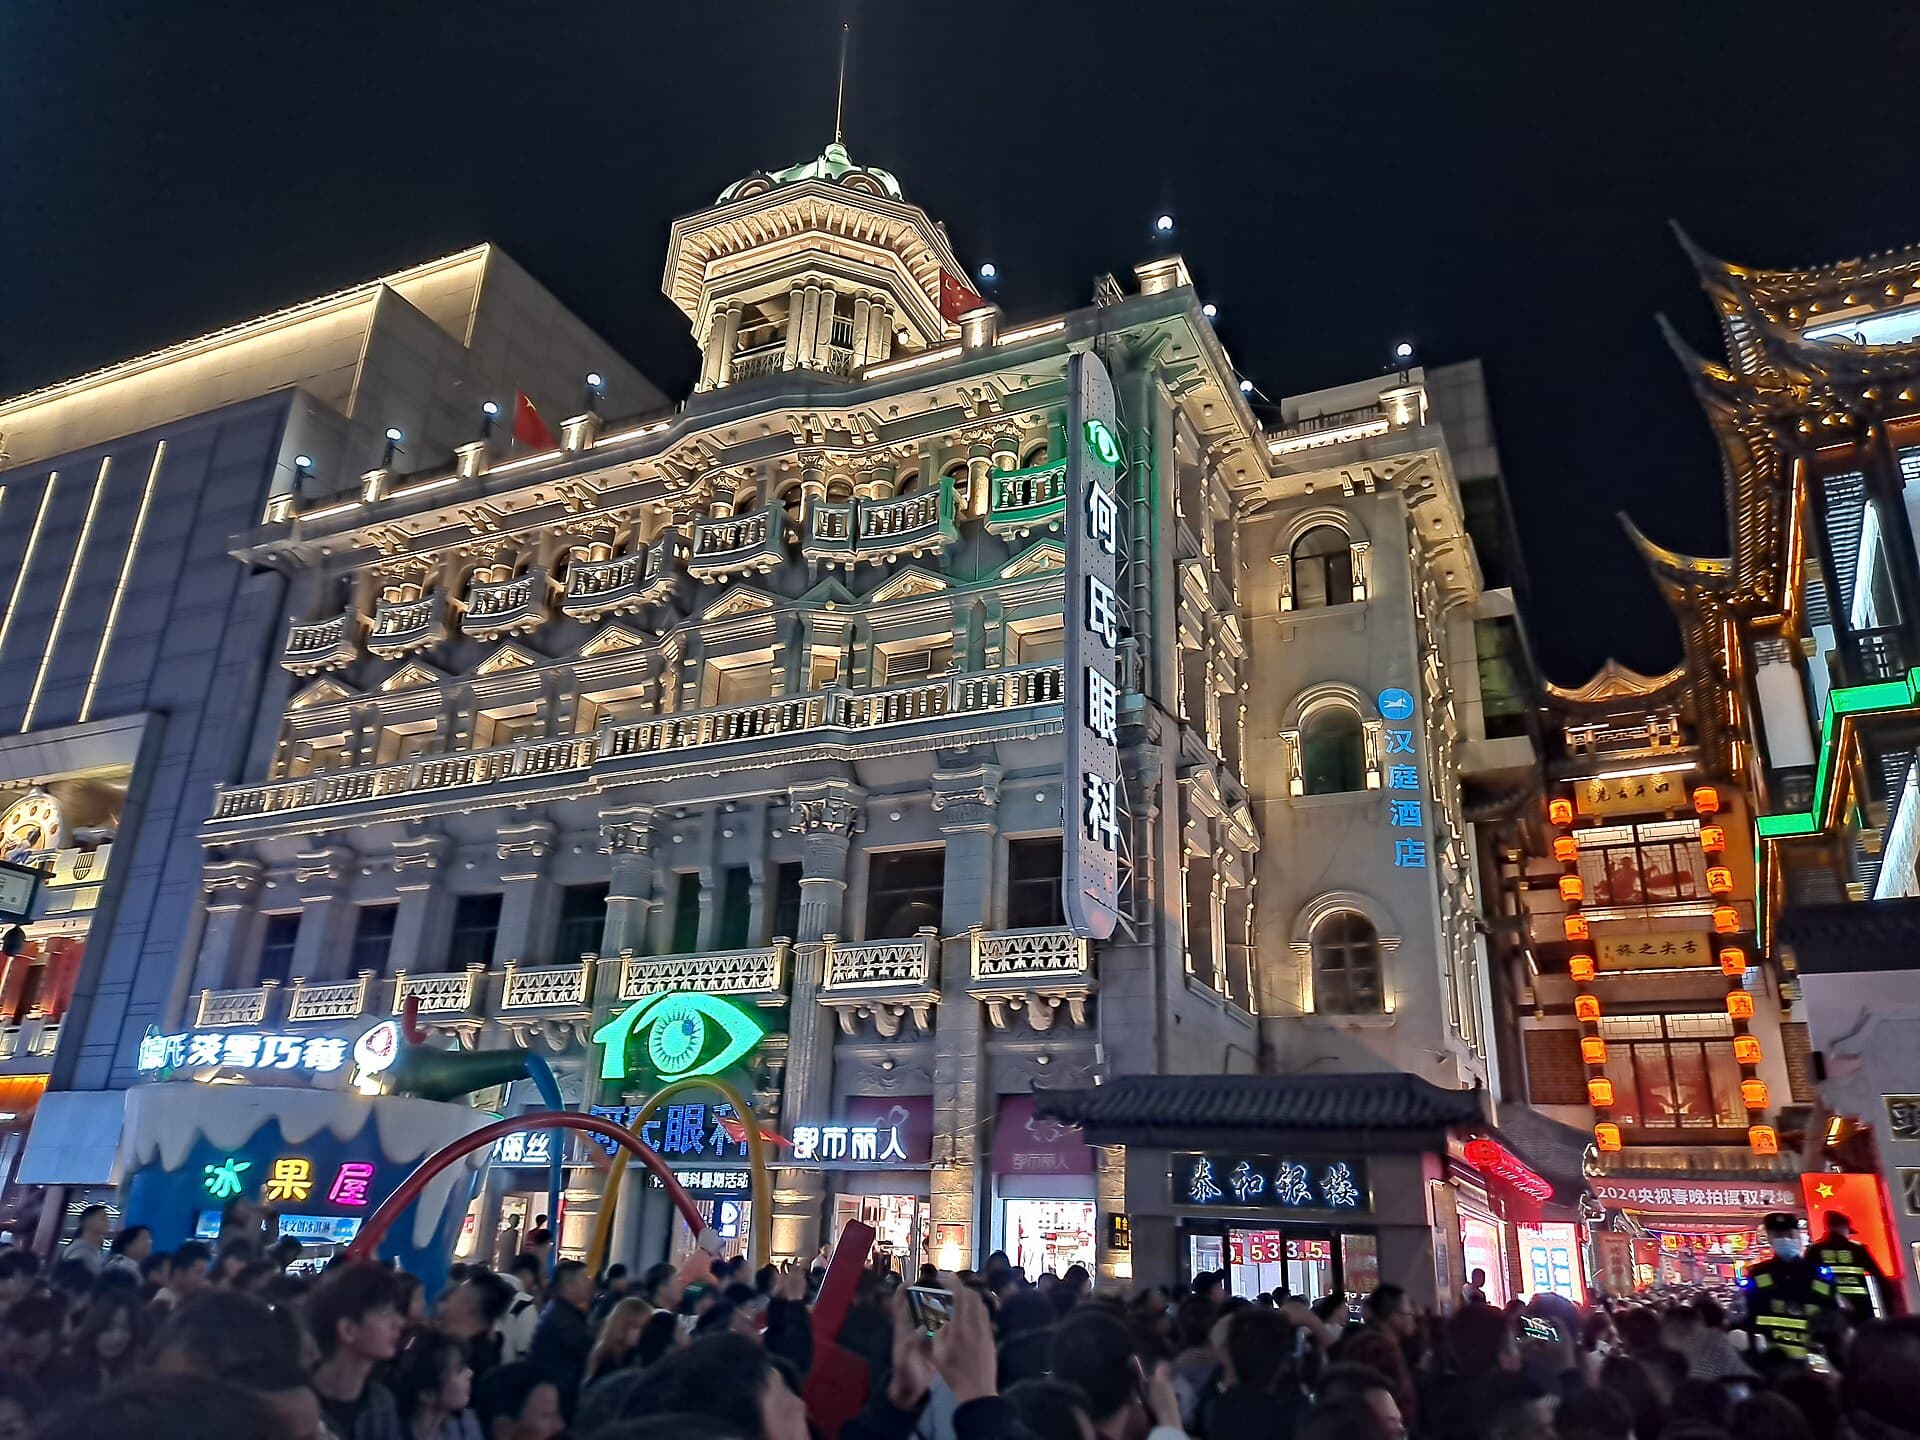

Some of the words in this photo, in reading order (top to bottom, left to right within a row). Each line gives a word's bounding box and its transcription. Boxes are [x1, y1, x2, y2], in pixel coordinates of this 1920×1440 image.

[1087, 480, 1120, 853] 何氏眼科
[1384, 728, 1427, 869] 汉庭酒店
[204, 1157, 376, 1206] 冰果屋
[793, 1126, 908, 1161] 都市丽人
